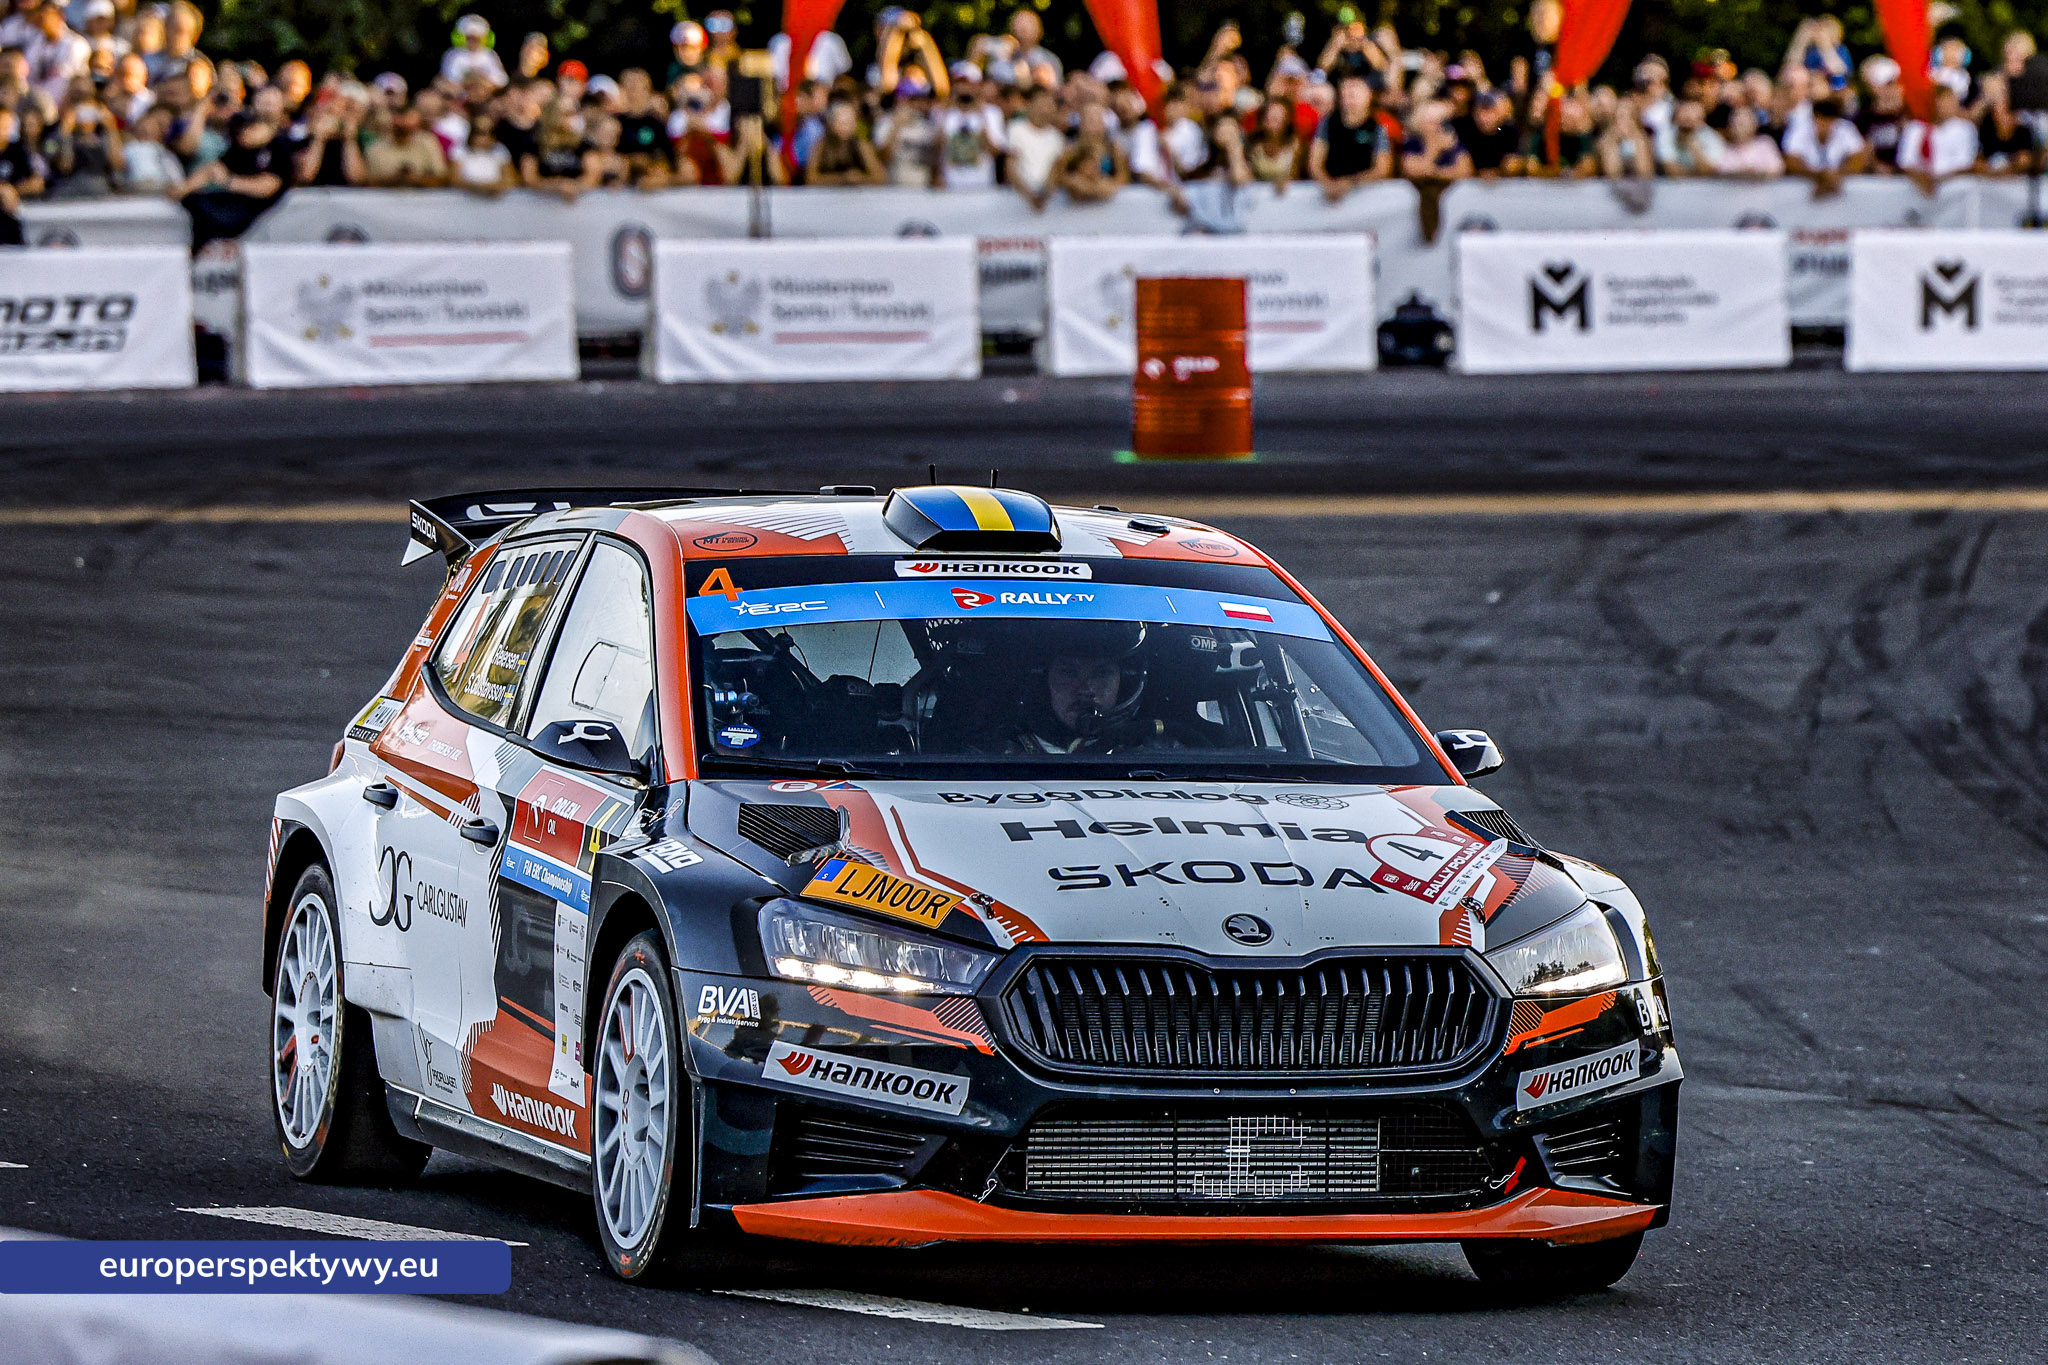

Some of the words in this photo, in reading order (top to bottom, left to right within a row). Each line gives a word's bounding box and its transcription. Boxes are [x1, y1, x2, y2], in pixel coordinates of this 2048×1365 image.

[698, 568, 743, 601] 4
[1191, 637, 1217, 650] OMP
[551, 796, 581, 820] ORLEN
[547, 818, 556, 835] OIL
[1001, 817, 1369, 843] Helmia
[1387, 841, 1444, 861] 4
[522, 859, 532, 876] FIA
[541, 865, 573, 897] Championship
[1048, 861, 1388, 896] SKODA
[1423, 868, 1456, 899] RALLY
[1451, 841, 1485, 872] POLAND
[417, 880, 468, 929] CARLGUSTAV
[698, 985, 750, 1018] BVA
